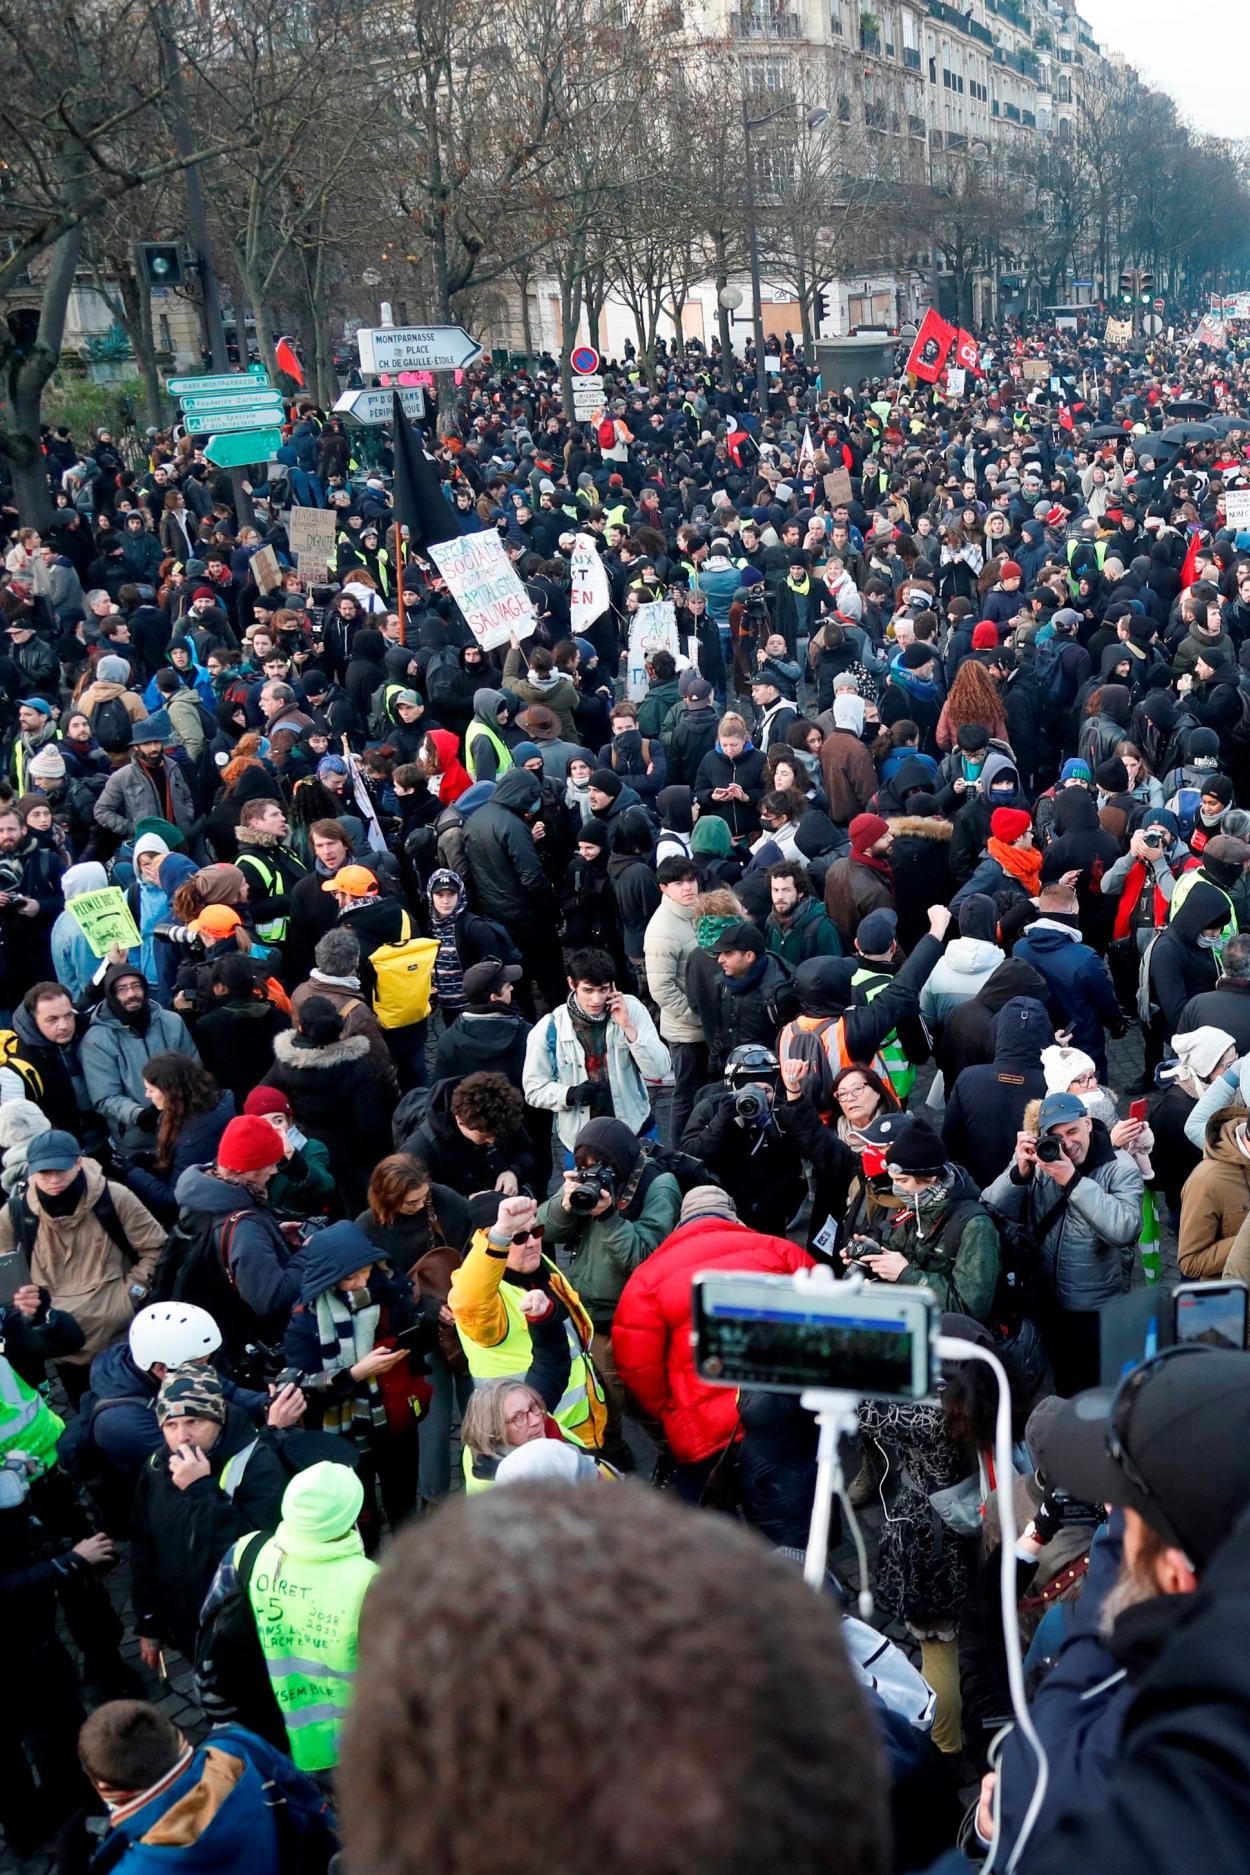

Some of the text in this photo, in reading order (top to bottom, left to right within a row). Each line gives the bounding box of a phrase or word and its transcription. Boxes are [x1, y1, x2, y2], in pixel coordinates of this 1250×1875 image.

[376, 333, 435, 344] MONTPARNASSE
[406, 345, 429, 354] PLACE
[404, 355, 455, 367] GAULLE-ÉTOILE
[202, 379, 255, 388] MONTPARNASSE
[380, 391, 419, 404] D'OÉANS
[370, 403, 420, 418] PÉRIPHIQUE
[443, 543, 502, 579] SOCIALE
[469, 593, 529, 635] SAUVAGE
